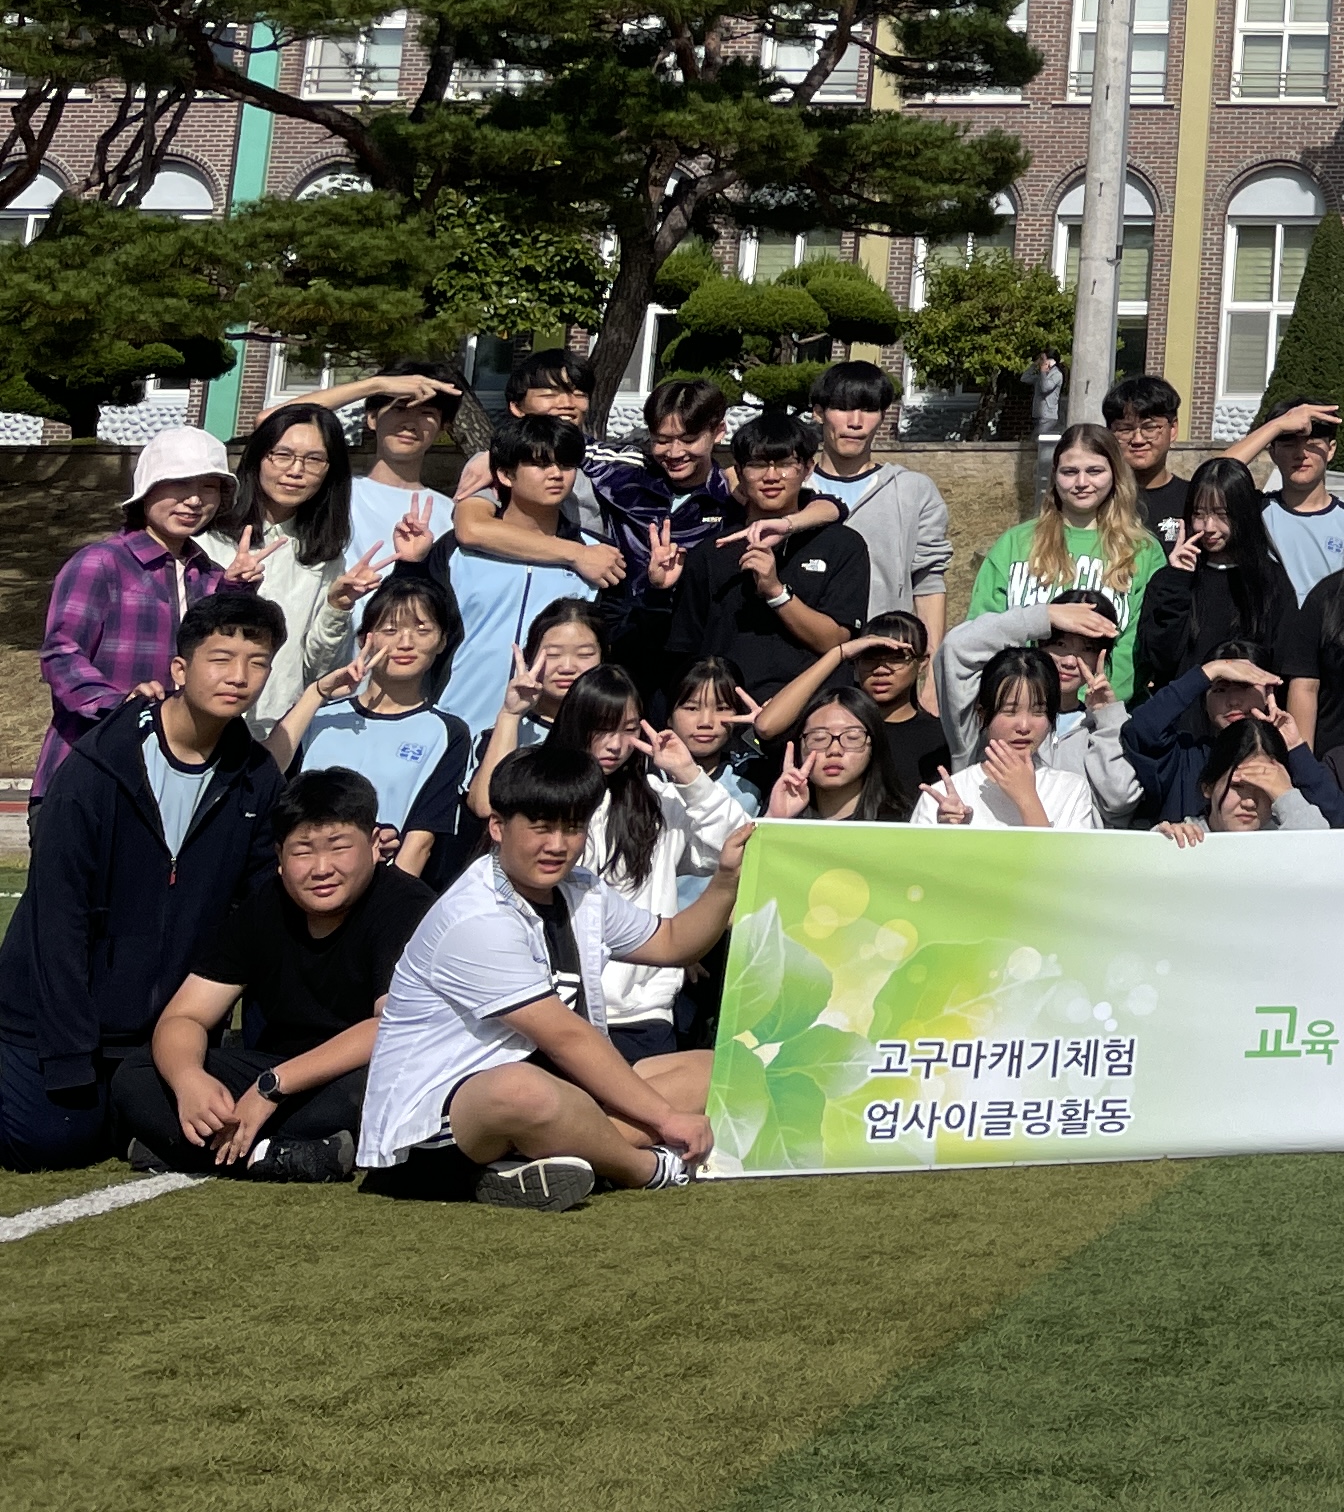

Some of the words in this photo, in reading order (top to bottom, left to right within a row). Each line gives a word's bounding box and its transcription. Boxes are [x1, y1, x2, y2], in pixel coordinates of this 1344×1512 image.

[1245, 1006, 1339, 1065] 교육
[871, 1038, 1135, 1080] 고구마캐기체험
[867, 1098, 1132, 1140] 업사이클링활동
